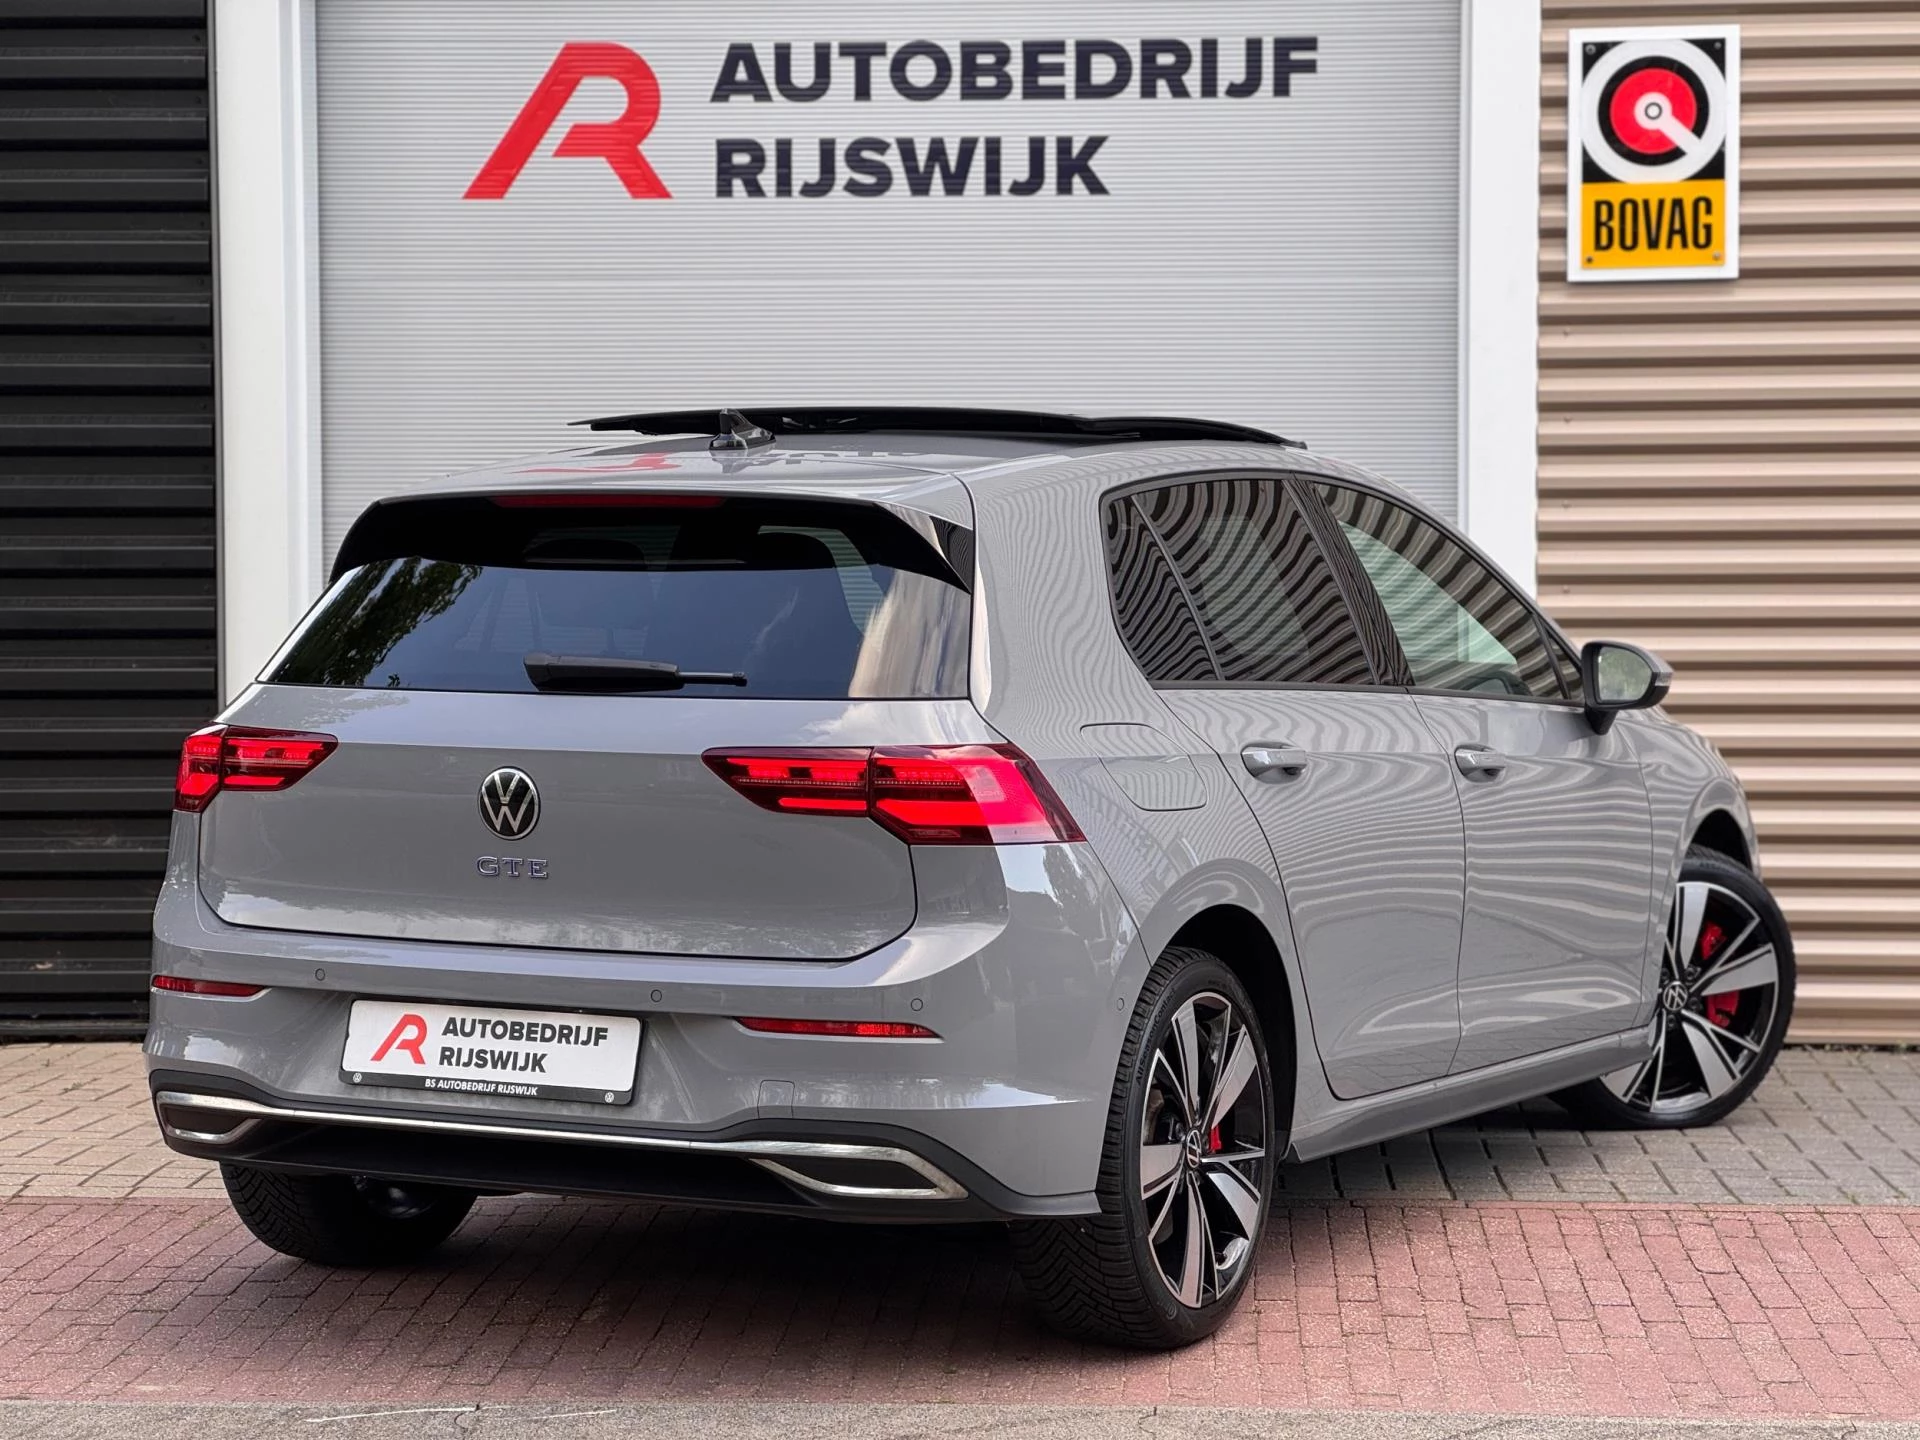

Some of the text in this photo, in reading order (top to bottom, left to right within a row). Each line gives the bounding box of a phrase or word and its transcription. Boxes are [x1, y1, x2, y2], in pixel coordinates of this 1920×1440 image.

[711, 37, 1318, 102] AUTOBEDRIJF
[716, 136, 1109, 198] RIJSWIJK
[1594, 196, 1713, 252] BOVAG
[477, 856, 549, 879] GTE
[441, 1017, 609, 1047] AUTOBEDRIJF
[439, 1046, 547, 1073] RIJSWIJK
[425, 1078, 538, 1096] BS AUTOBEDRIJF RIJSWIJK
